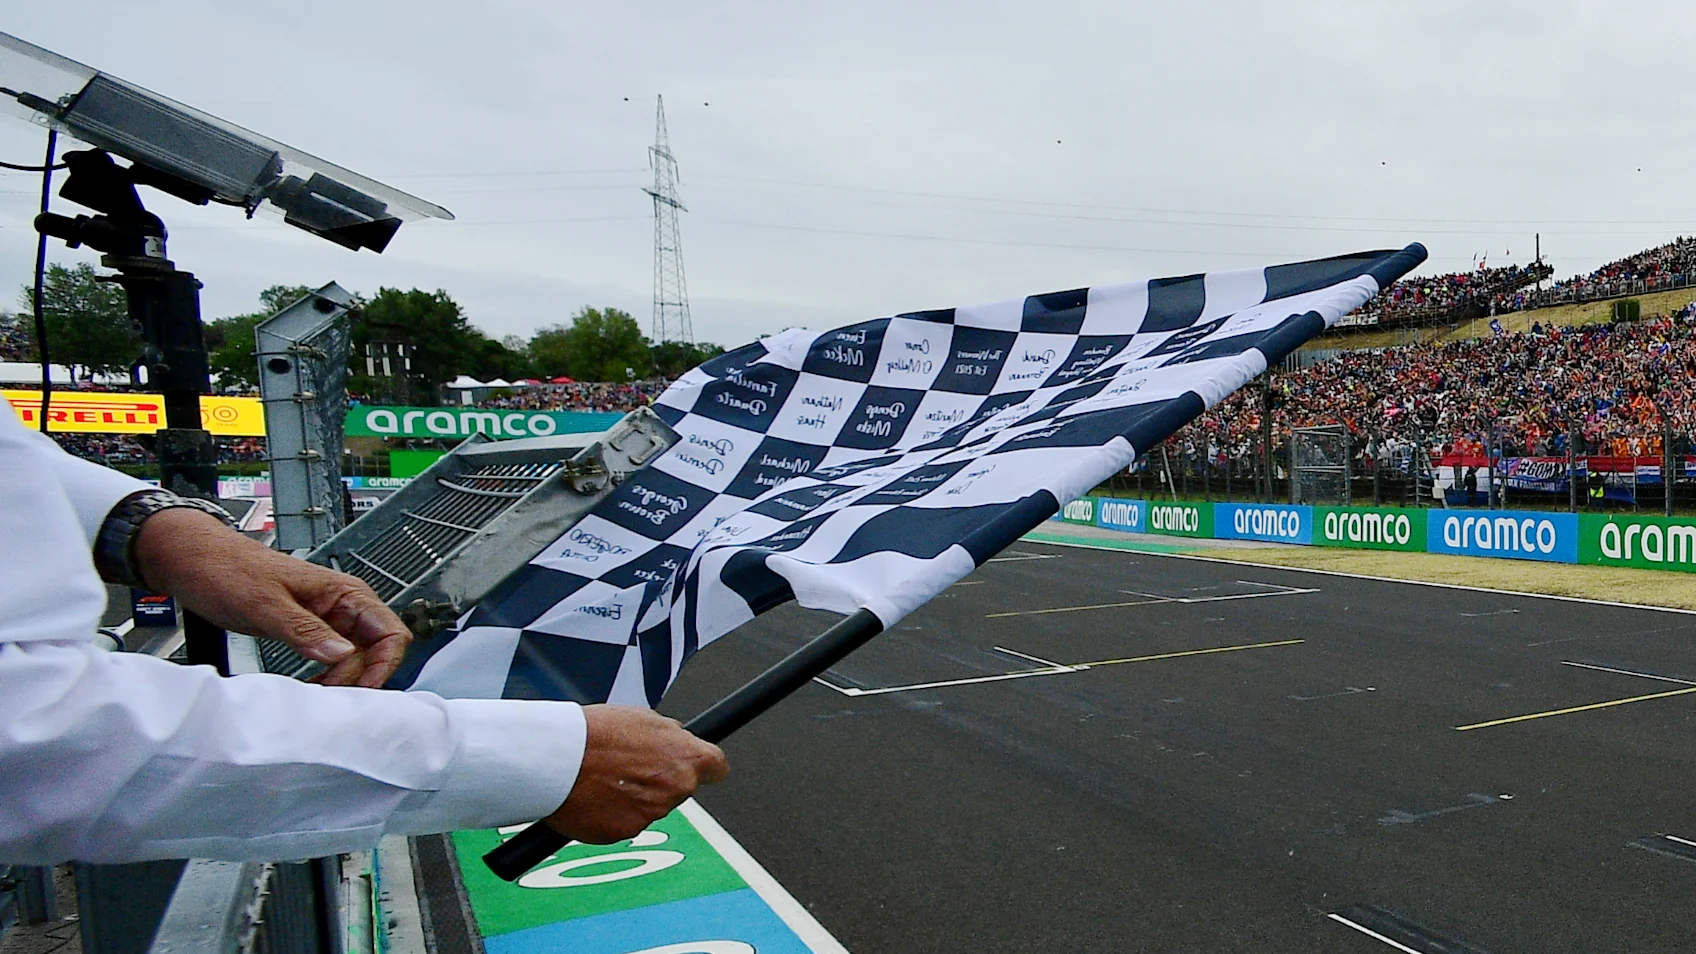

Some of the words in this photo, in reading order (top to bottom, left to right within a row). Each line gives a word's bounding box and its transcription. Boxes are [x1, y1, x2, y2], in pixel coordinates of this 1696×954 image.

[366, 410, 556, 440] aramco
[1064, 501, 1093, 521] aramco
[1101, 502, 1139, 527] aramco
[1152, 506, 1199, 531] aramco
[1234, 508, 1300, 538] aramco
[1324, 512, 1410, 545] aramco
[1444, 516, 1556, 553] aramco
